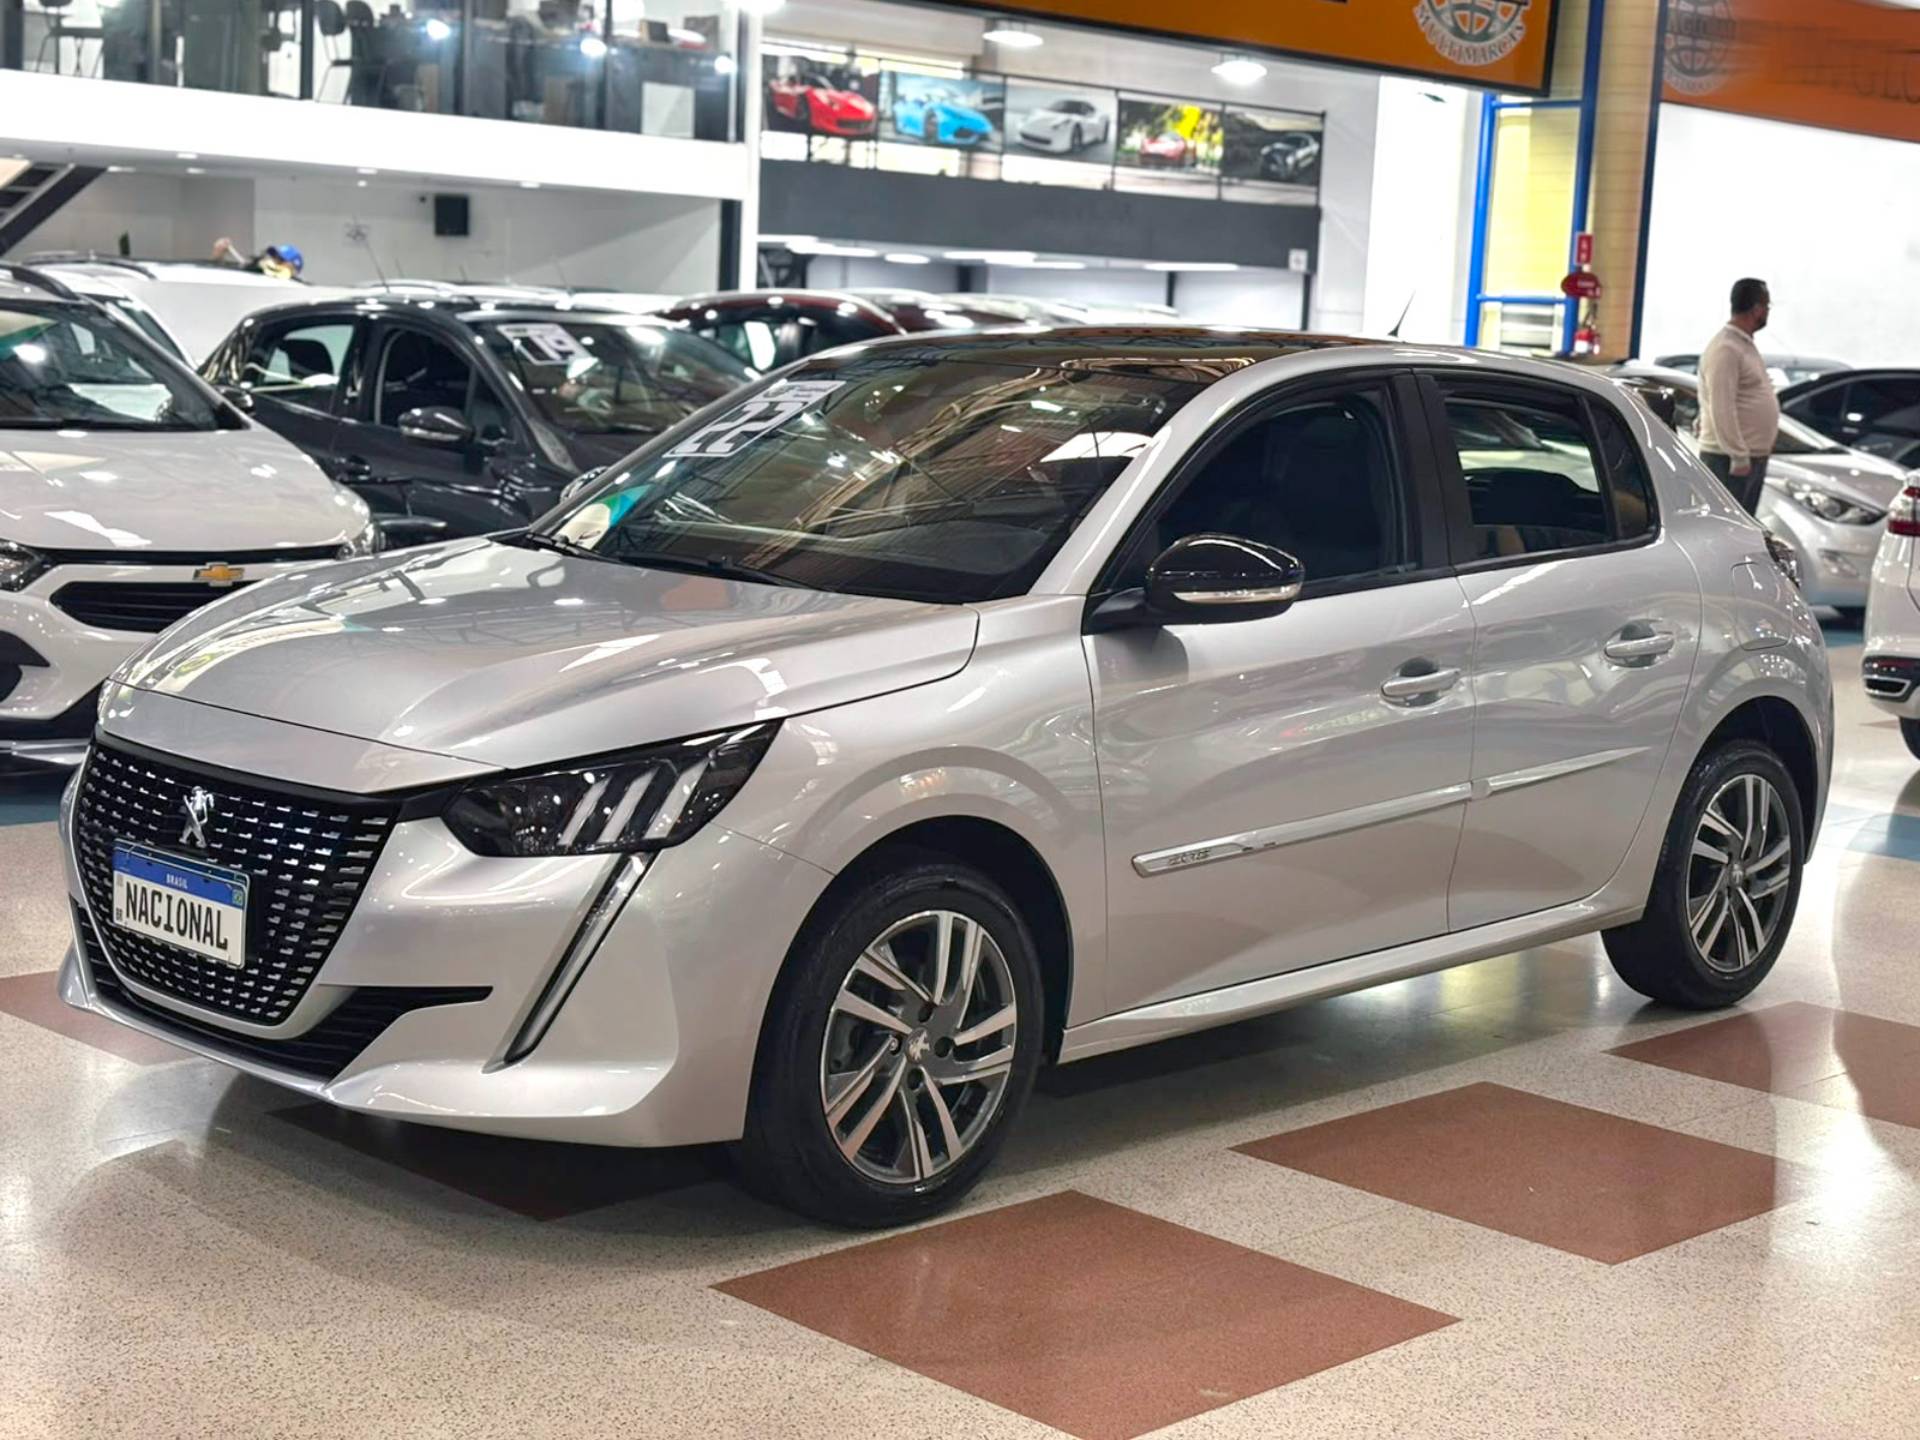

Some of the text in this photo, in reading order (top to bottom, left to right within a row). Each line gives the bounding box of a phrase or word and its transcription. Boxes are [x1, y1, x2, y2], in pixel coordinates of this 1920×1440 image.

[674, 401, 804, 453] 22
[165, 873, 189, 890] BRASIL
[125, 880, 229, 951] NACIONAL
